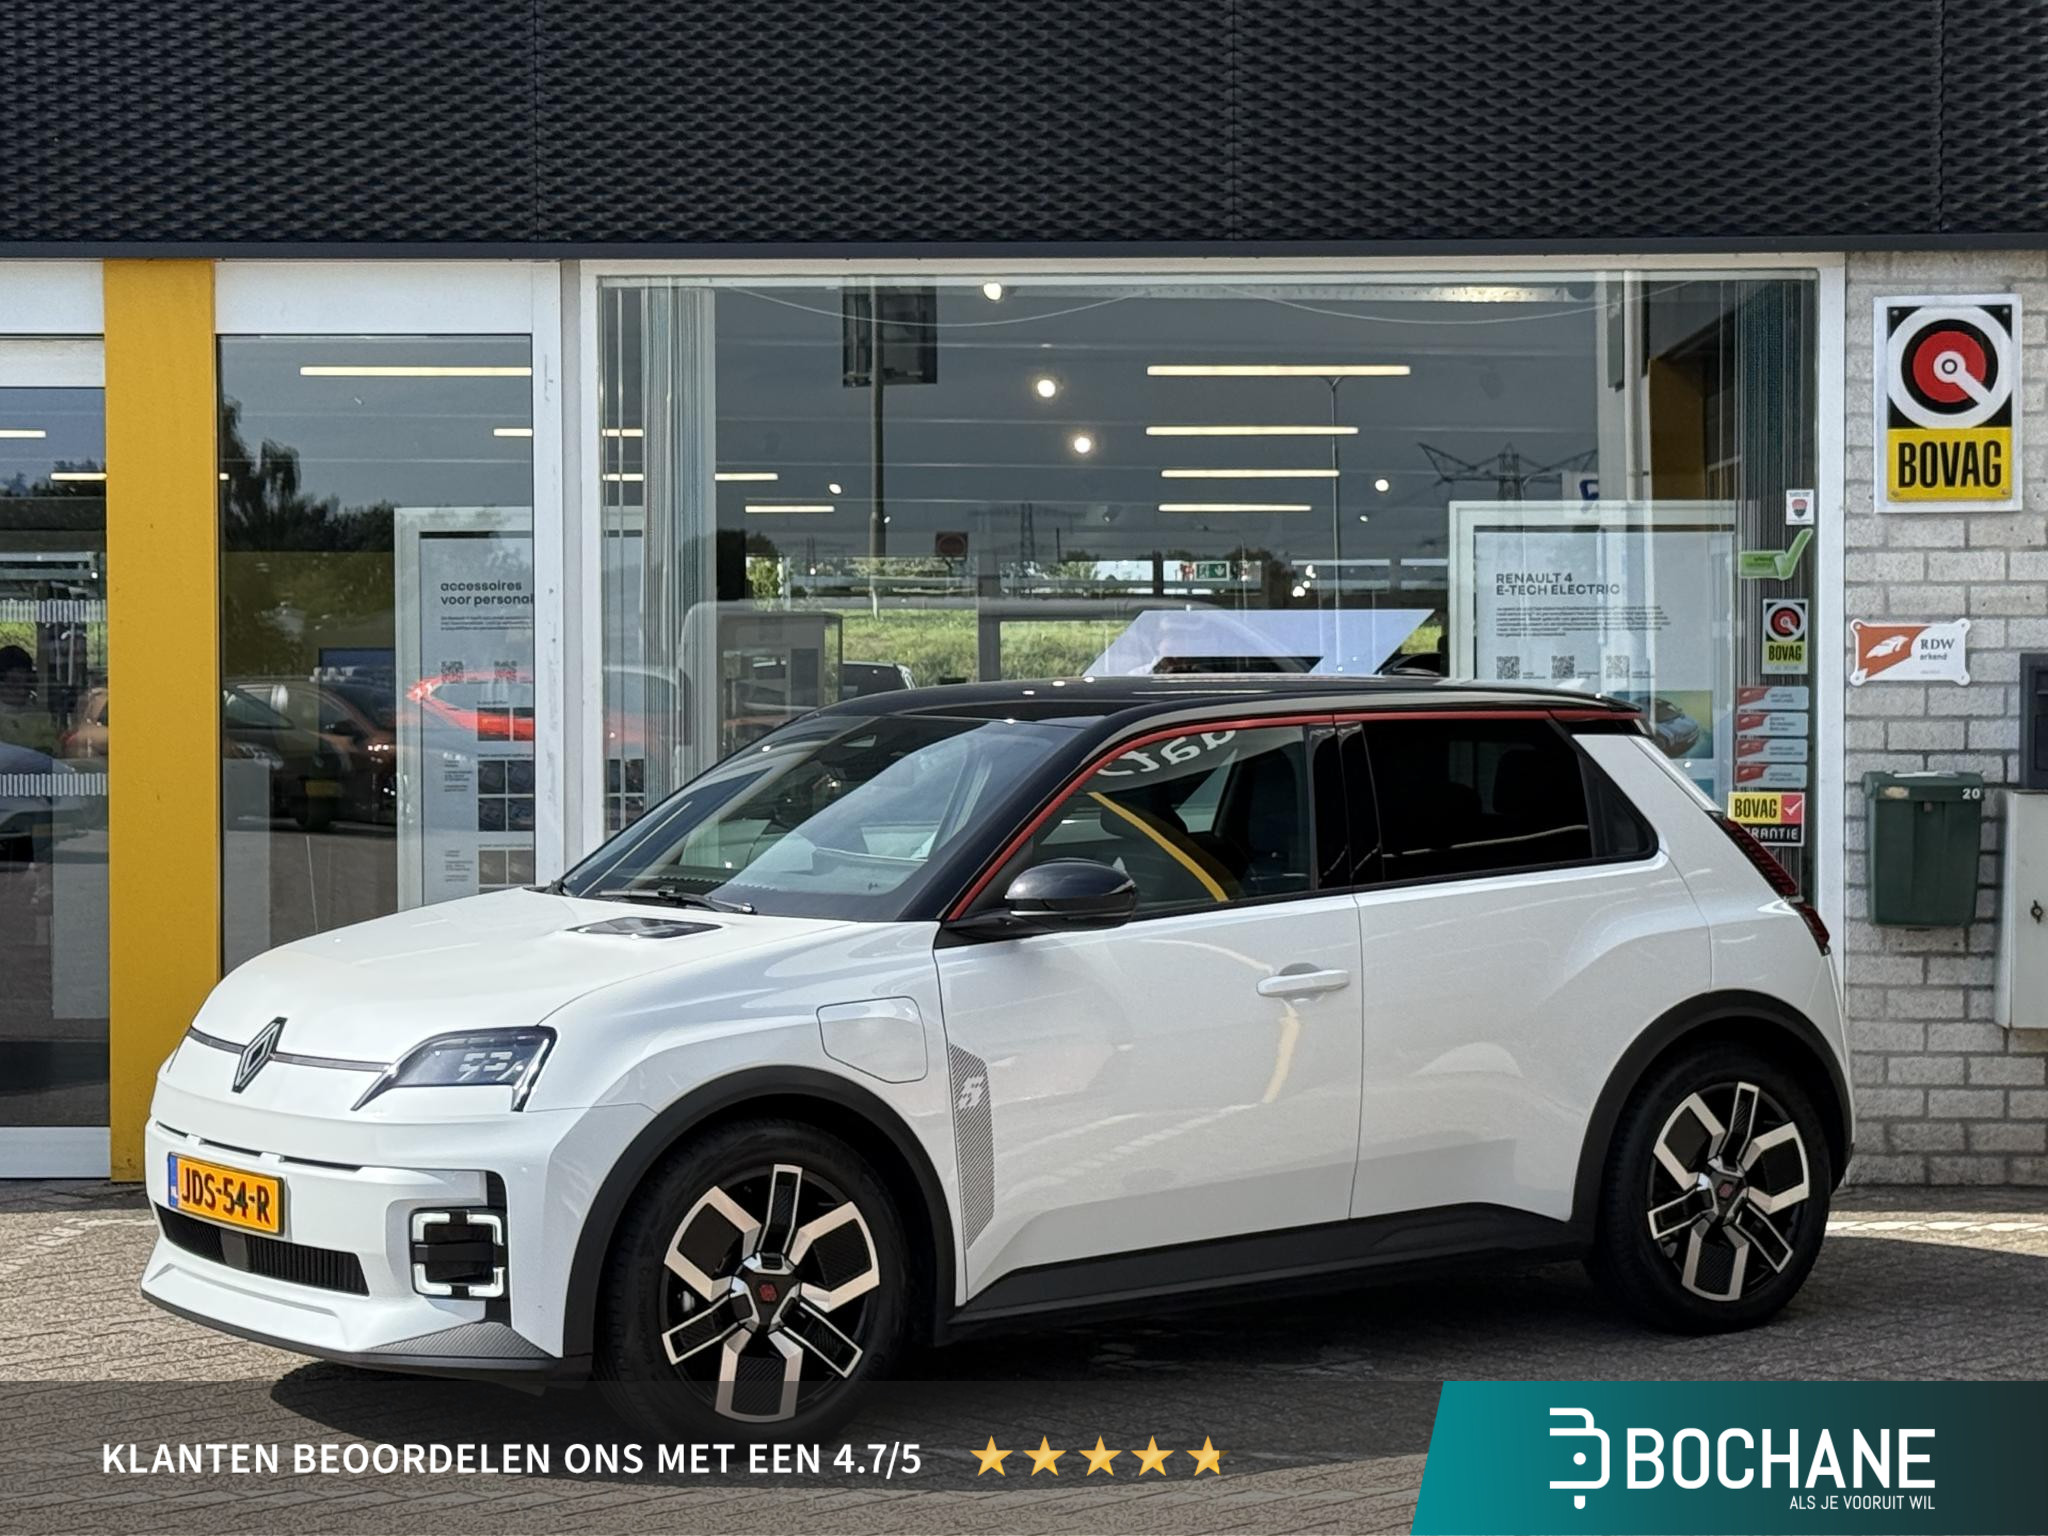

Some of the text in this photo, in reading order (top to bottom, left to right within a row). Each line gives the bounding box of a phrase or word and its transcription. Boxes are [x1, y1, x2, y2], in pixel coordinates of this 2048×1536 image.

[1898, 441, 2001, 488] BOVAG
[1496, 573, 1573, 584] RENAULT 4
[440, 580, 522, 592] accessoires
[1496, 584, 1621, 596] E-TECH ELECTRIC
[440, 596, 472, 605] voor
[1920, 638, 1955, 650] RDW
[1768, 644, 1802, 662] BOVAG
[1962, 788, 1981, 800] 20
[1734, 798, 1777, 818] BOVAG
[1746, 827, 1799, 840] RANTIE
[181, 1167, 272, 1225] JDS-54-R
